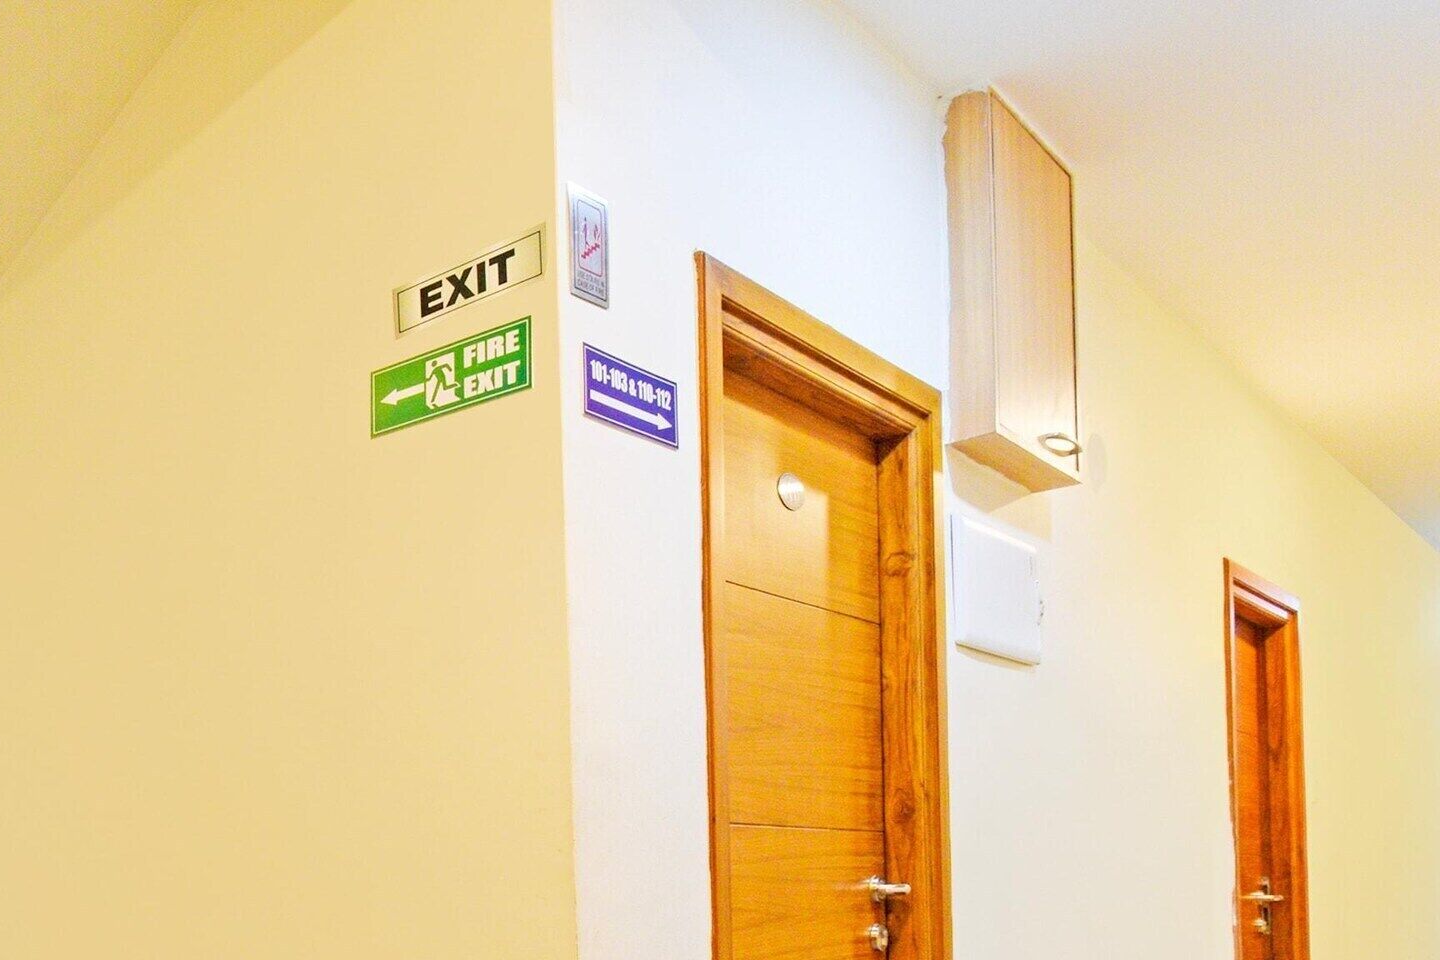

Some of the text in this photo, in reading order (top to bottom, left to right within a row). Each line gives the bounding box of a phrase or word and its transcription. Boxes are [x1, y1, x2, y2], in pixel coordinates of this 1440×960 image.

[420, 248, 515, 318] EXIT
[463, 328, 520, 369] FIRE
[463, 360, 520, 399] EXIT
[590, 359, 672, 411] 101-103 & 110-112
